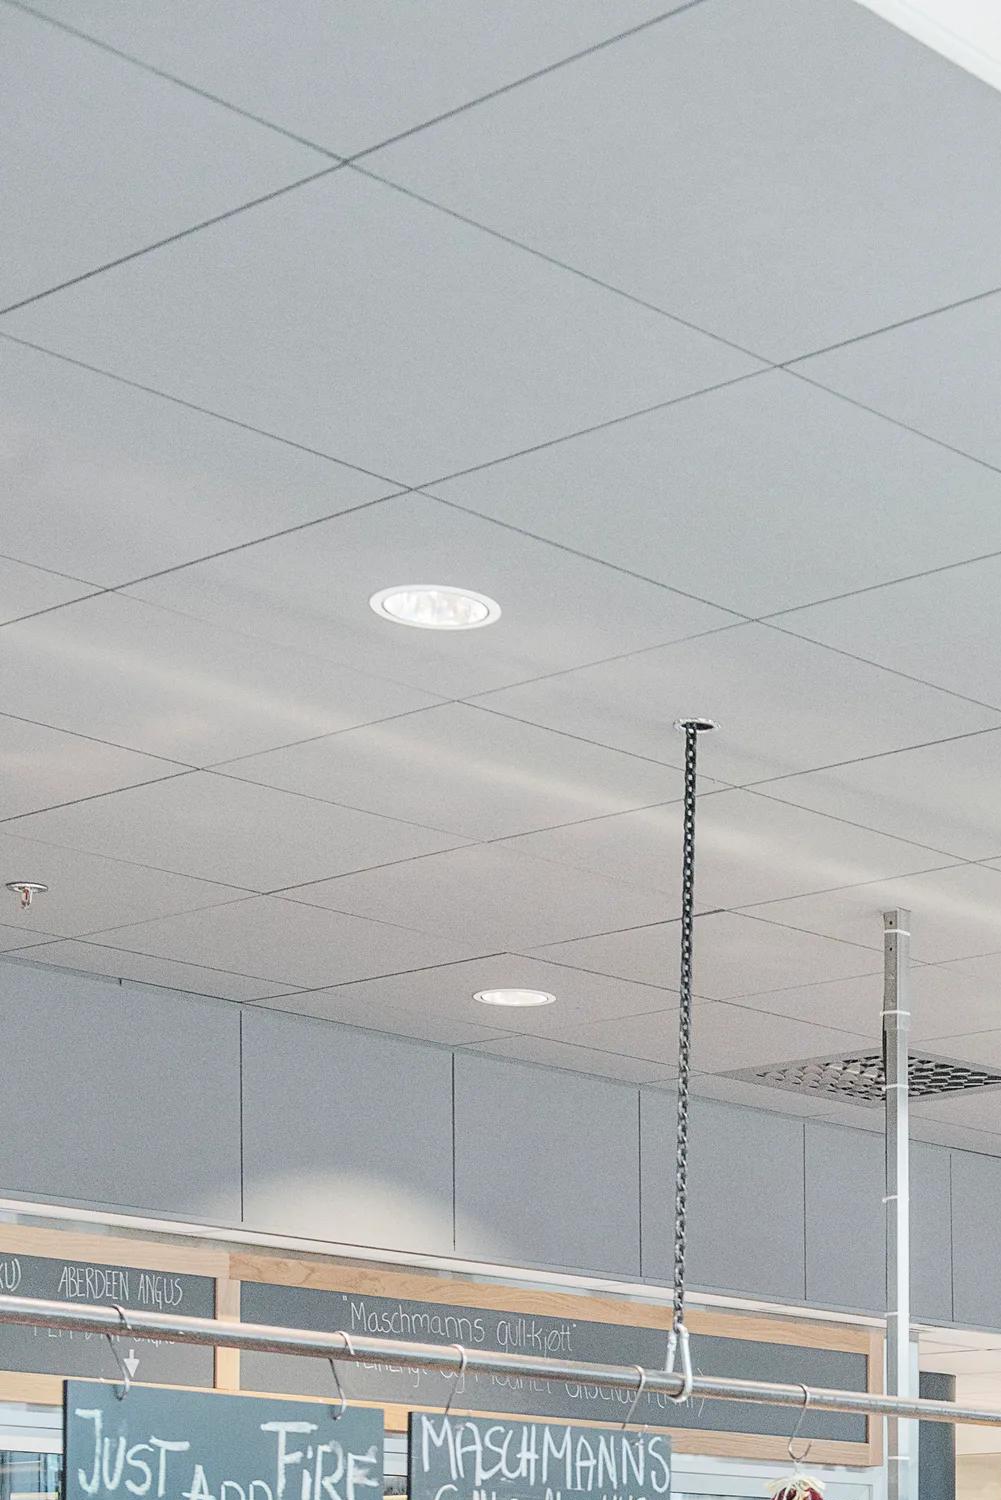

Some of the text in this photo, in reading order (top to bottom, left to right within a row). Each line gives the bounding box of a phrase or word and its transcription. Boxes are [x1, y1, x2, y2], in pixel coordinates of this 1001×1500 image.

[57, 1265, 183, 1310] ABERDEEN ANGUS
[75, 1408, 191, 1498] JUST
[421, 1414, 671, 1494] MASCHMANNS
